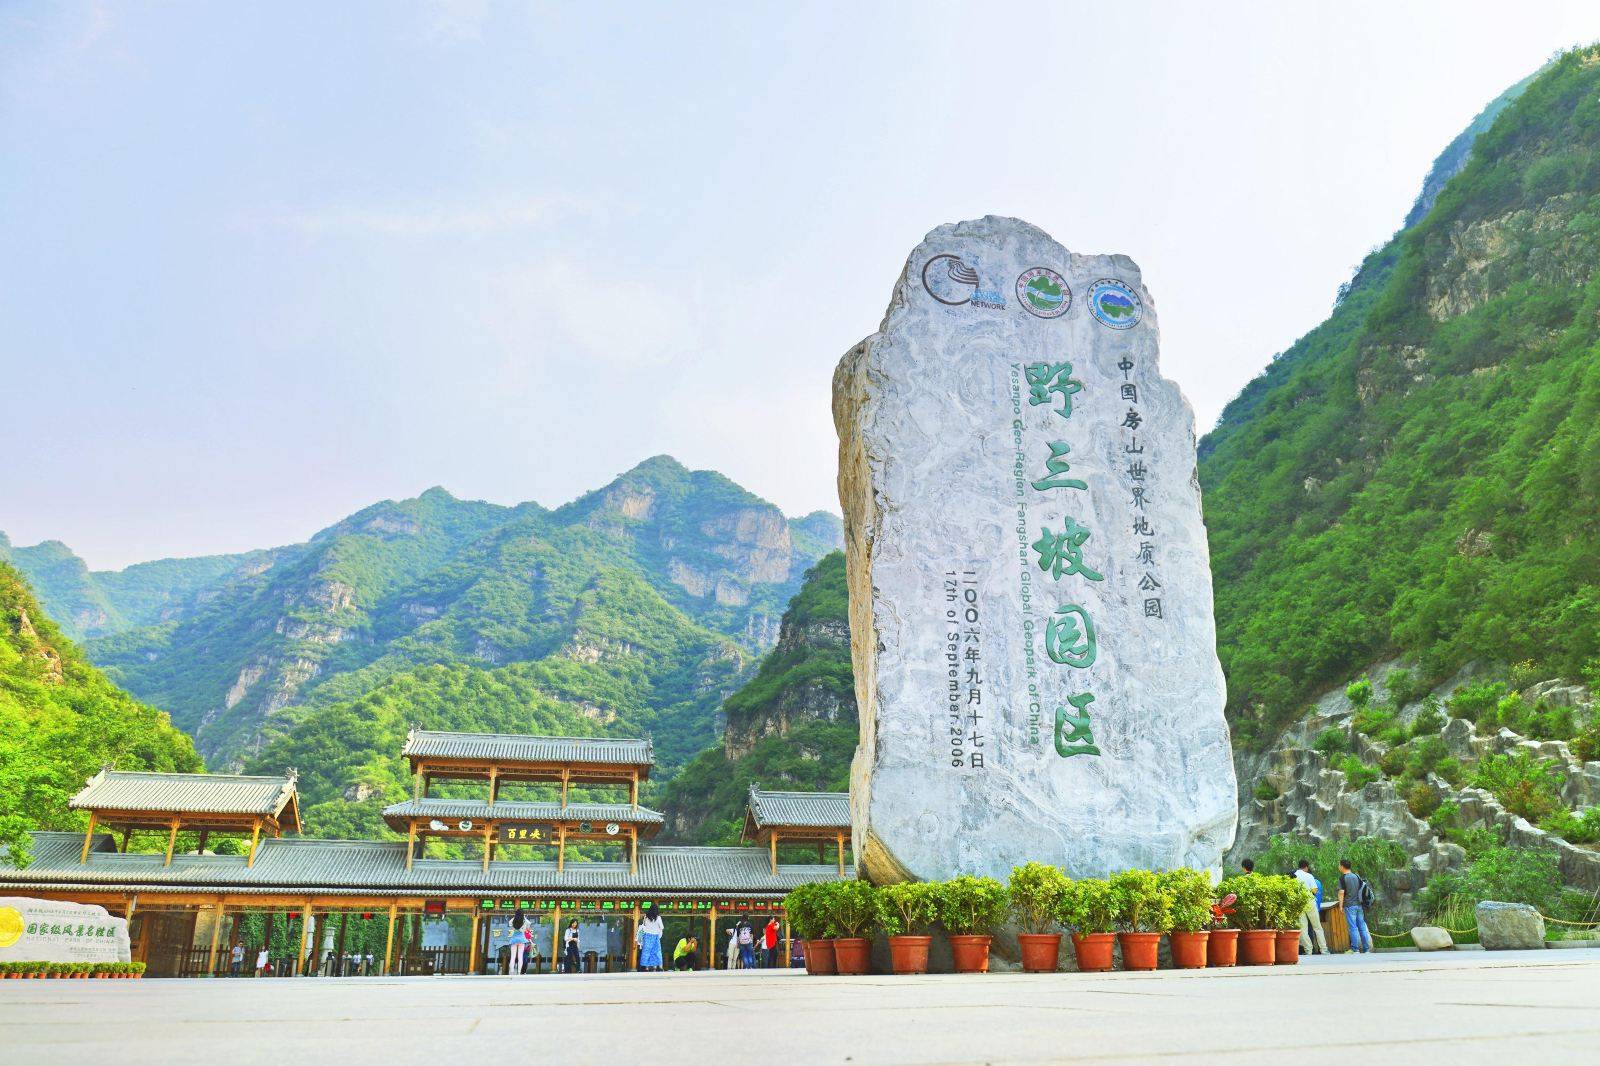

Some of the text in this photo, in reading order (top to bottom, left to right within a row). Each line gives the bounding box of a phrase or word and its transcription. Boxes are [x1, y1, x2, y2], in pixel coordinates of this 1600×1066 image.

[970, 300, 1006, 311] NETWORK
[1010, 362, 1022, 415] Yesanpo
[1117, 356, 1163, 620] 中国房山世界地质公园
[1015, 502, 1029, 566] Fangshan
[1023, 361, 1104, 759] 野三坡园区
[945, 571, 958, 602] 17th
[1019, 571, 1032, 615] Global
[946, 610, 959, 625] of
[1023, 620, 1037, 679] Geopark
[1028, 683, 1039, 700] of
[1029, 703, 1041, 745] China
[27, 922, 117, 938] 国家级风景名胜区
